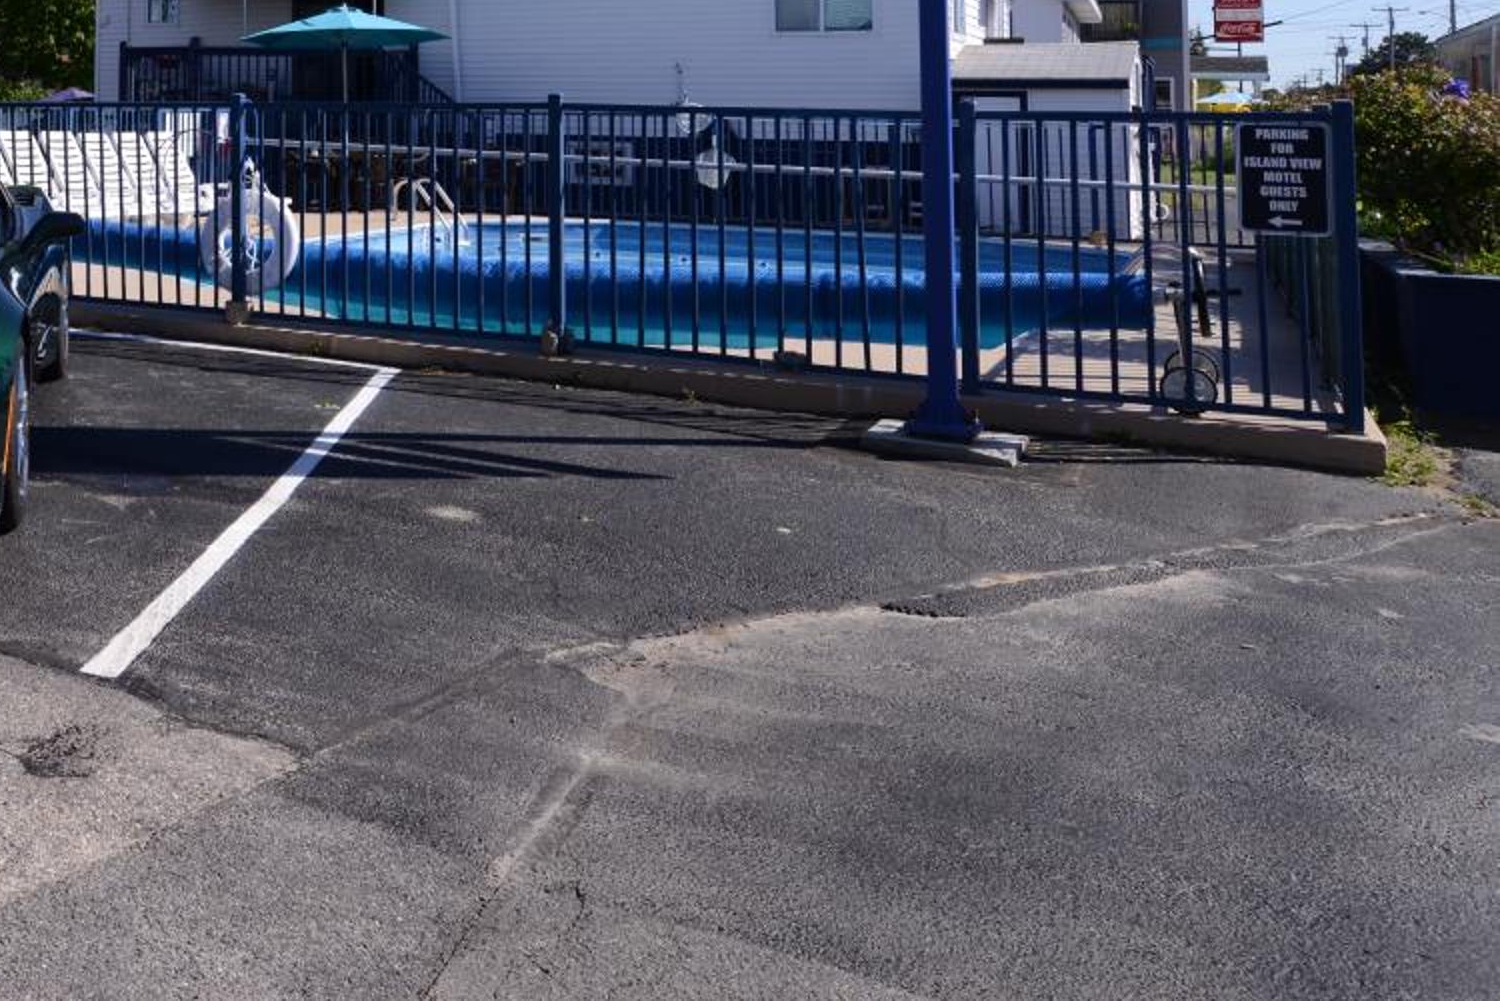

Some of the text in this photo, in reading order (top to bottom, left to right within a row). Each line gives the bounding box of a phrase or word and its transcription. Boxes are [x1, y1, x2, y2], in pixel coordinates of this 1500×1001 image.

[1255, 128, 1309, 141] PARKING
[1270, 142, 1295, 154] FOR
[1243, 156, 1323, 170] ISLAND VIEW
[1263, 170, 1303, 184] MOTEL
[1260, 185, 1308, 198] GUESTS
[1269, 200, 1299, 212] ONLY
